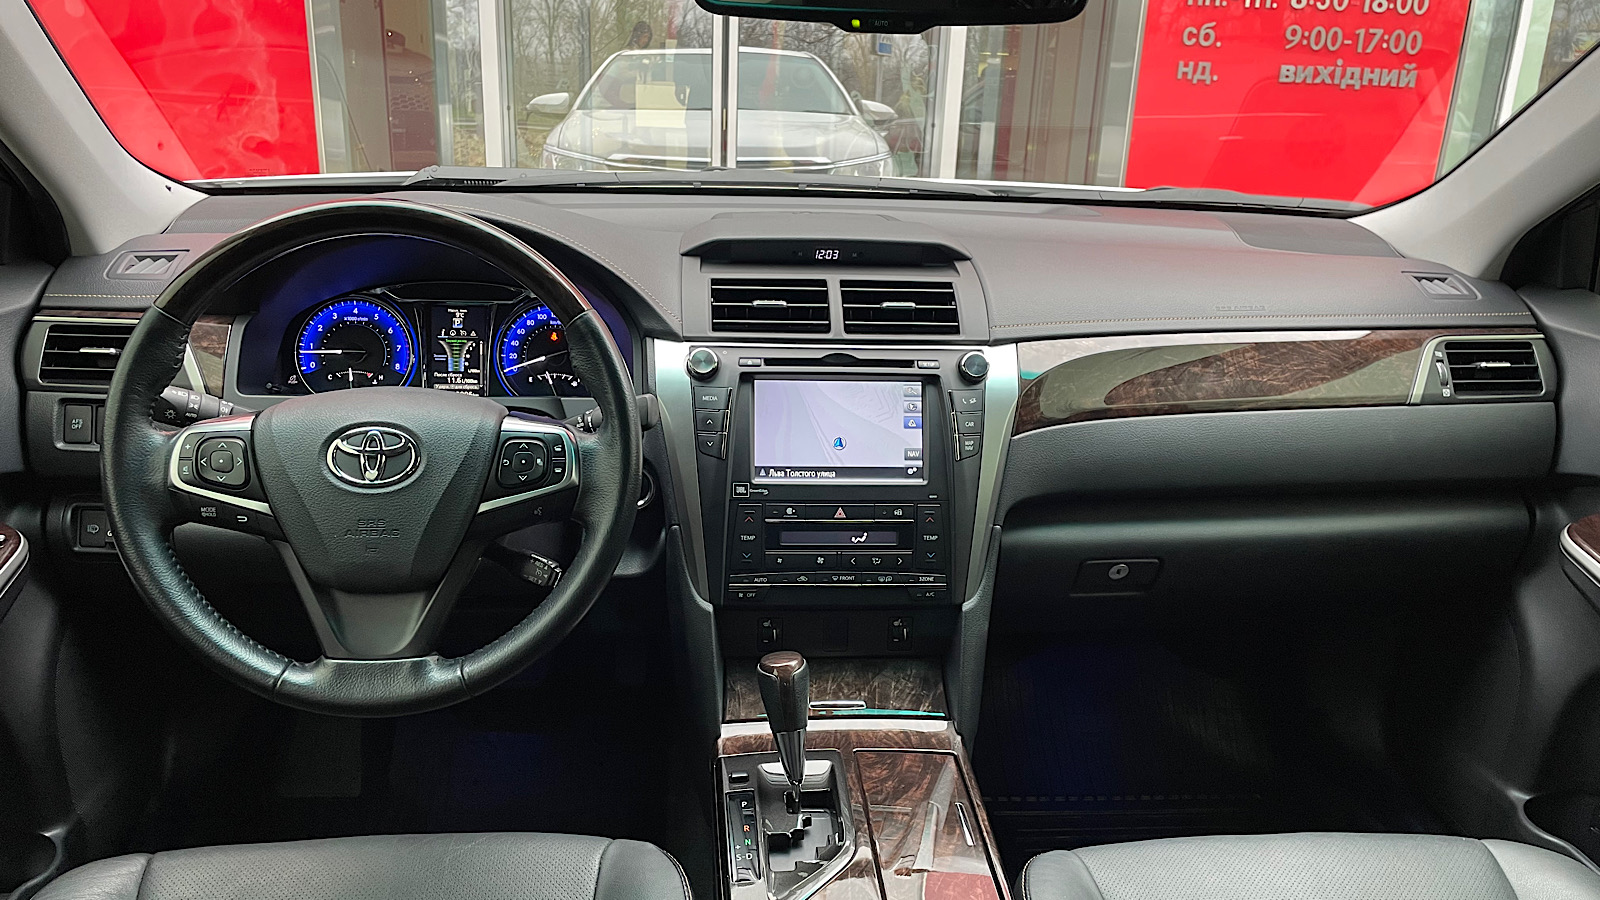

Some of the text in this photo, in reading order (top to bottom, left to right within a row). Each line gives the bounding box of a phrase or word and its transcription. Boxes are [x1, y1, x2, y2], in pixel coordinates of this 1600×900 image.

[1182, 22, 1423, 56] сб. 9:00-17:00
[1177, 58, 1418, 90] нд. вихідний
[816, 250, 840, 260] 12:03
[768, 468, 836, 478] Льва Толстого улица
[344, 530, 400, 538] AIRBAG
